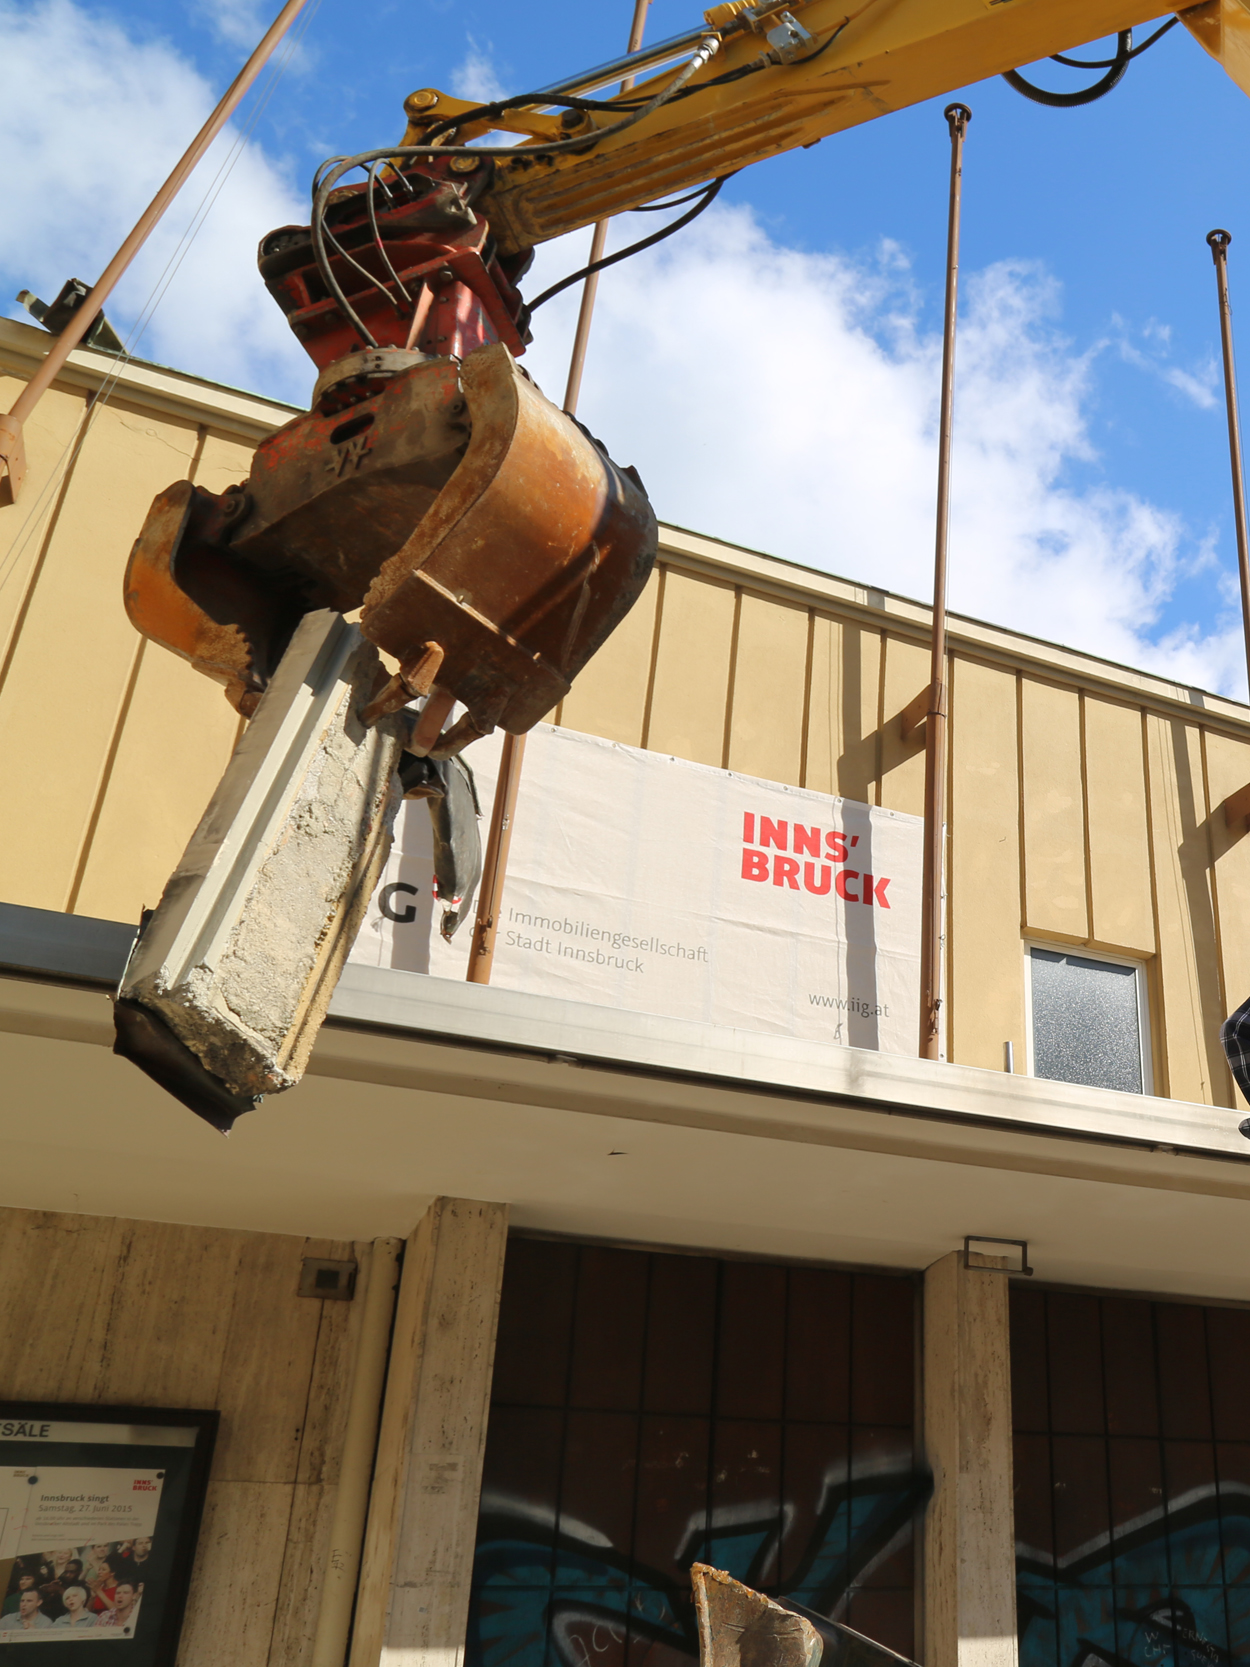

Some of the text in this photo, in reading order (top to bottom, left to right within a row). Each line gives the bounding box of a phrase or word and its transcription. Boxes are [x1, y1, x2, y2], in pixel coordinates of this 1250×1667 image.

[743, 811, 860, 864] INNS'
[740, 847, 891, 910] BRUCK
[505, 929, 552, 955] Stadt
[558, 942, 645, 974] Innsbruck
[508, 906, 710, 963] Immobiliengesellschaft
[808, 993, 890, 1018] www.iig.at
[0, 1422, 51, 1437] SÄLE
[40, 1494, 110, 1504] Innsbruck singt
[78, 1504, 91, 1512] 27.
[92, 1504, 110, 1513] Juni
[111, 1504, 133, 1512] 2015
